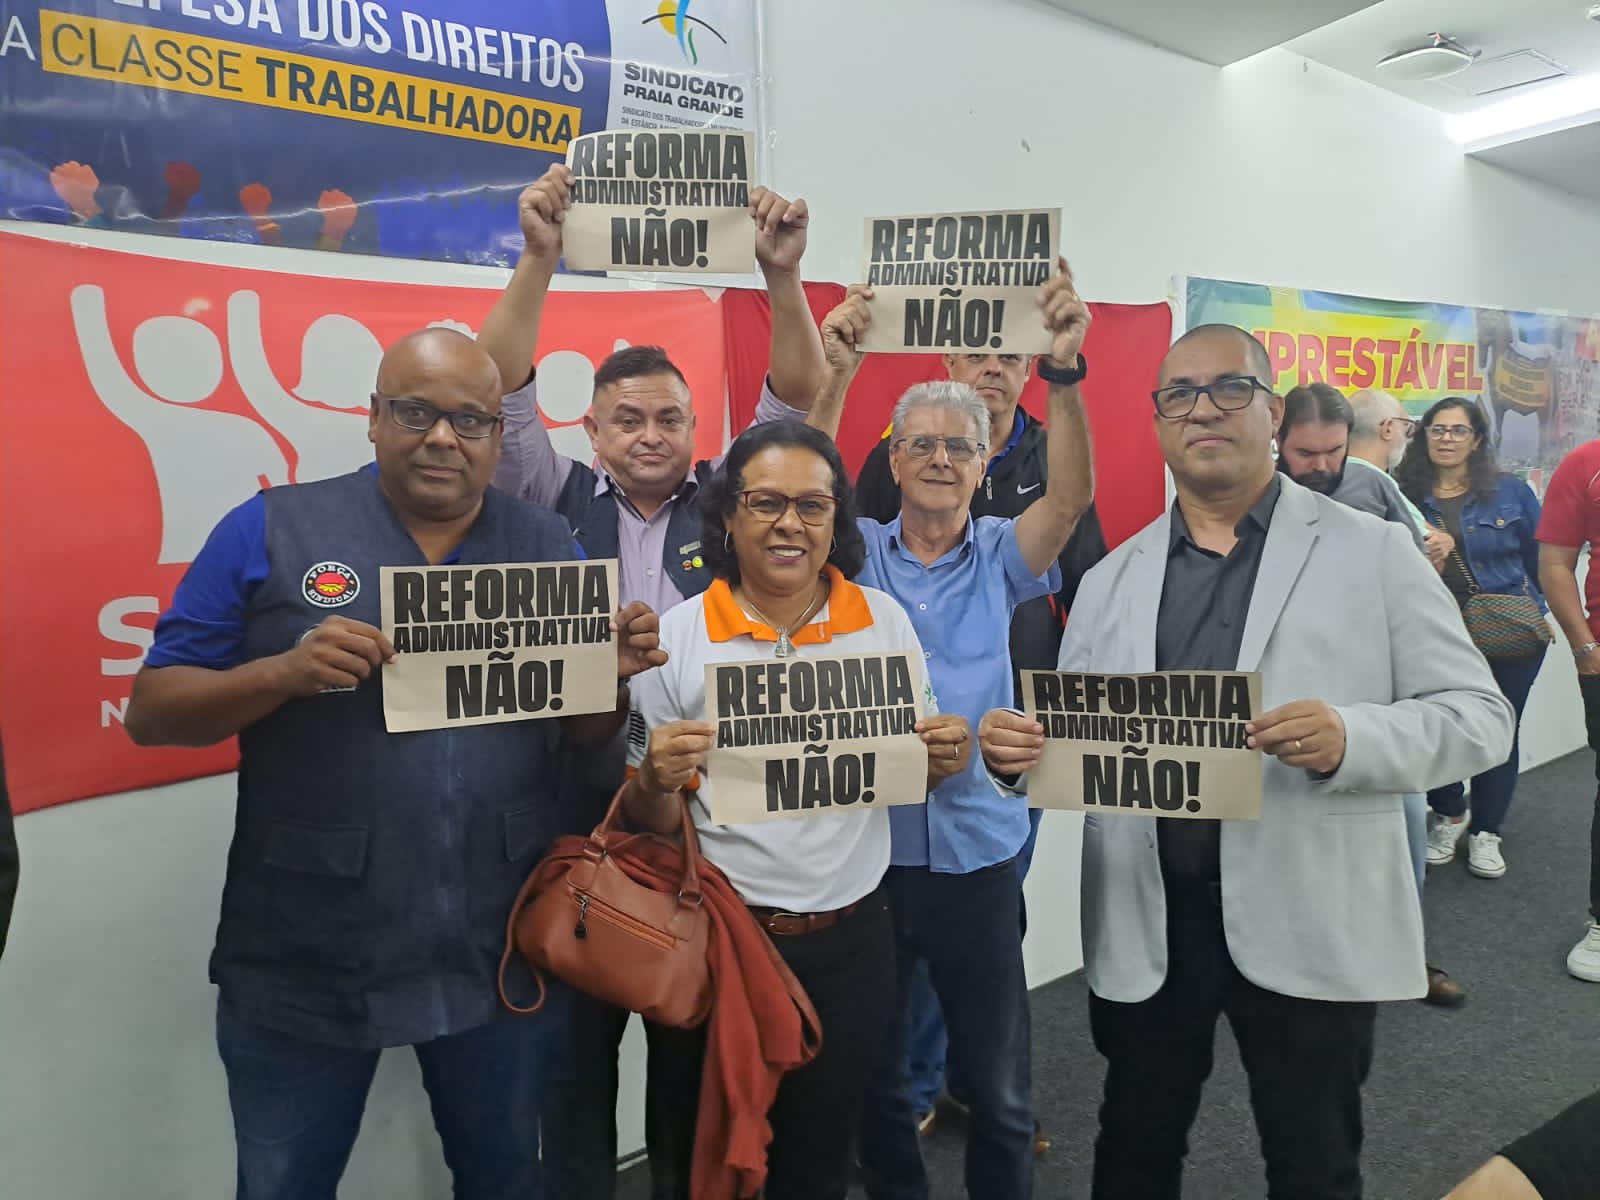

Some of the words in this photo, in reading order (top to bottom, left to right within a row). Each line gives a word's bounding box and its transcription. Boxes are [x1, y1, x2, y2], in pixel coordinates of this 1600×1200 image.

[299, 0, 391, 54] DOS
[401, 11, 585, 93] DIREITOS
[0, 15, 36, 61] A
[52, 23, 243, 92] CLASSE
[256, 56, 573, 146] TRABALHADORA
[623, 83, 673, 106] PRAIA
[677, 95, 744, 119] GRANDE
[624, 62, 744, 103] SINDICATO
[572, 132, 748, 181] REFORMA
[570, 179, 749, 208] ADMINISTRATIVA
[611, 207, 709, 268] NÃO!
[871, 213, 1050, 262] REFORMA
[868, 260, 1050, 287] ADMINISTRATIVA
[903, 287, 1005, 349] NÃO!
[393, 565, 610, 624] REFORMA
[394, 616, 611, 654] ADMINISTRATIVA
[446, 651, 564, 720] NÃO!
[716, 655, 915, 718] REFORMA
[1032, 673, 1251, 720] REFORMA
[717, 707, 919, 748] ADMINISTRATIVA
[1036, 713, 1252, 750] ADMINISTRATIVA
[765, 743, 876, 812] NÃO!
[1082, 745, 1202, 813] NÃO!
